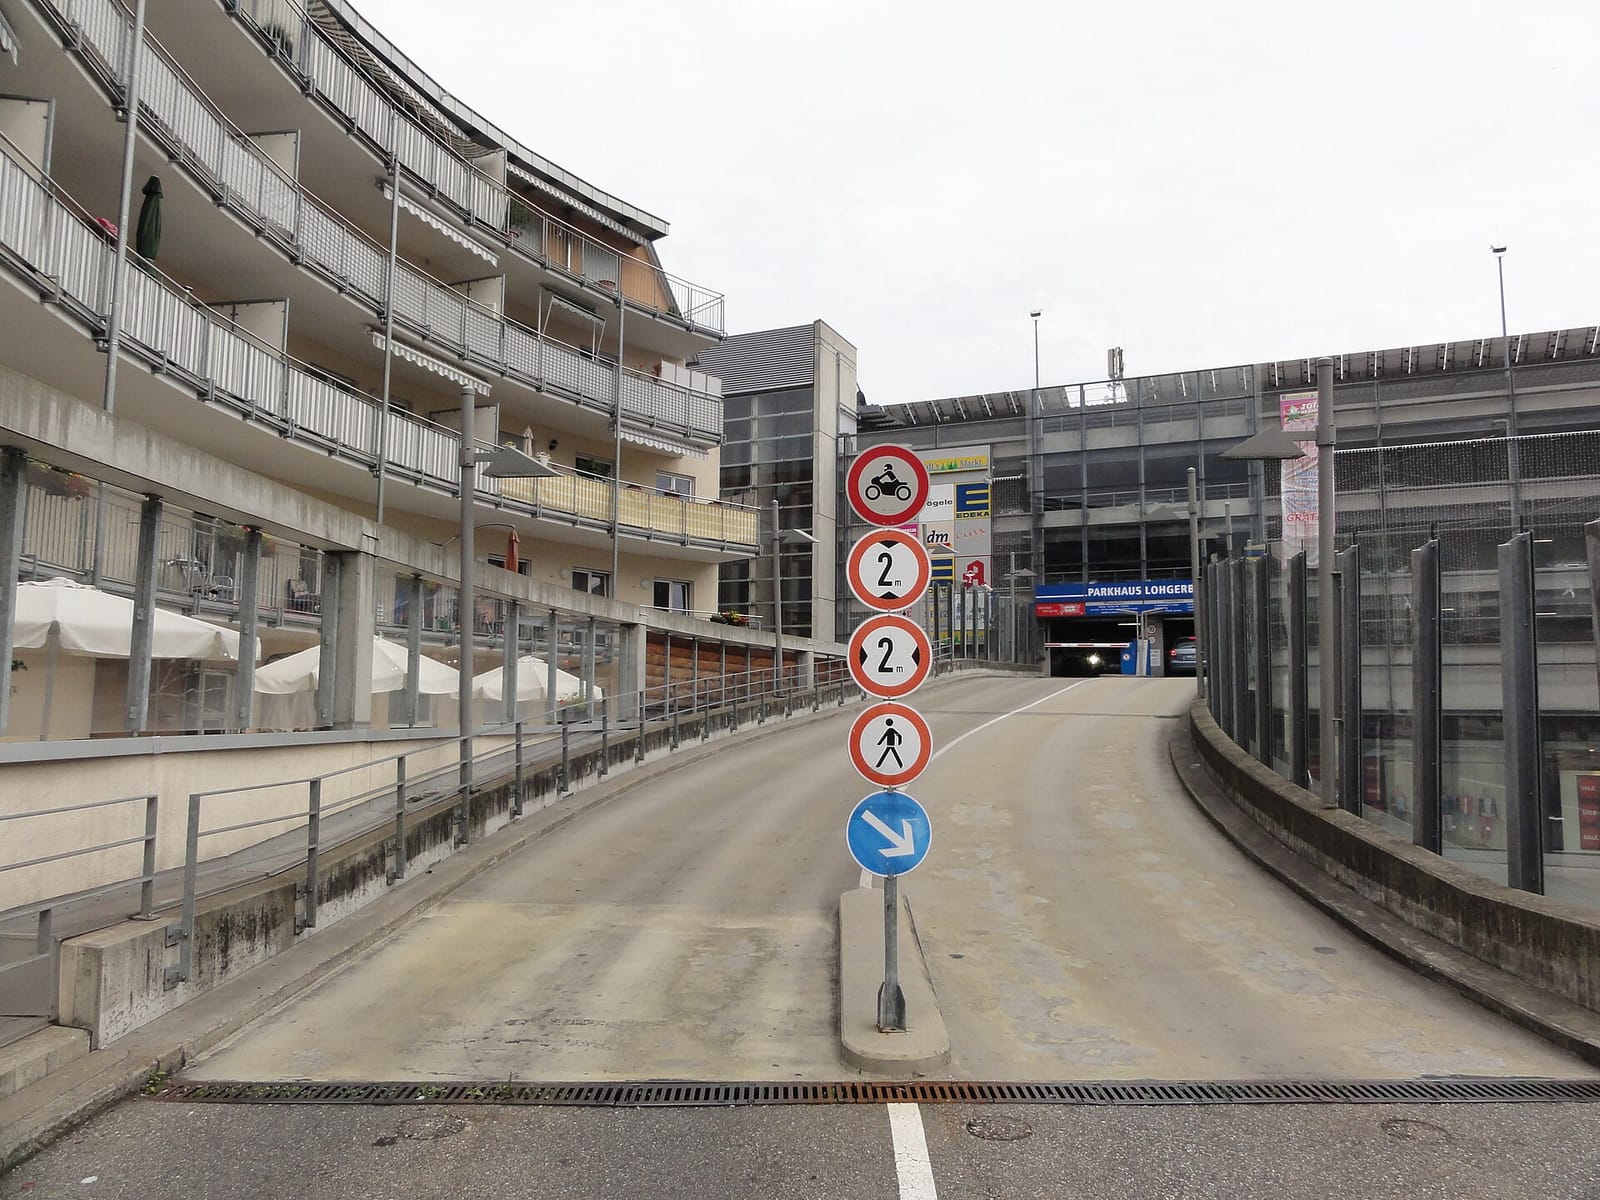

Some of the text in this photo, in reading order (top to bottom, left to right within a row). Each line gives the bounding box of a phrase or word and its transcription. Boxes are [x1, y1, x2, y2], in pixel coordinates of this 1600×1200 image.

[927, 530, 949, 543] dm
[878, 553, 893, 586] 2
[1088, 586, 1142, 597] PARKHAUS
[878, 637, 894, 673] 2
